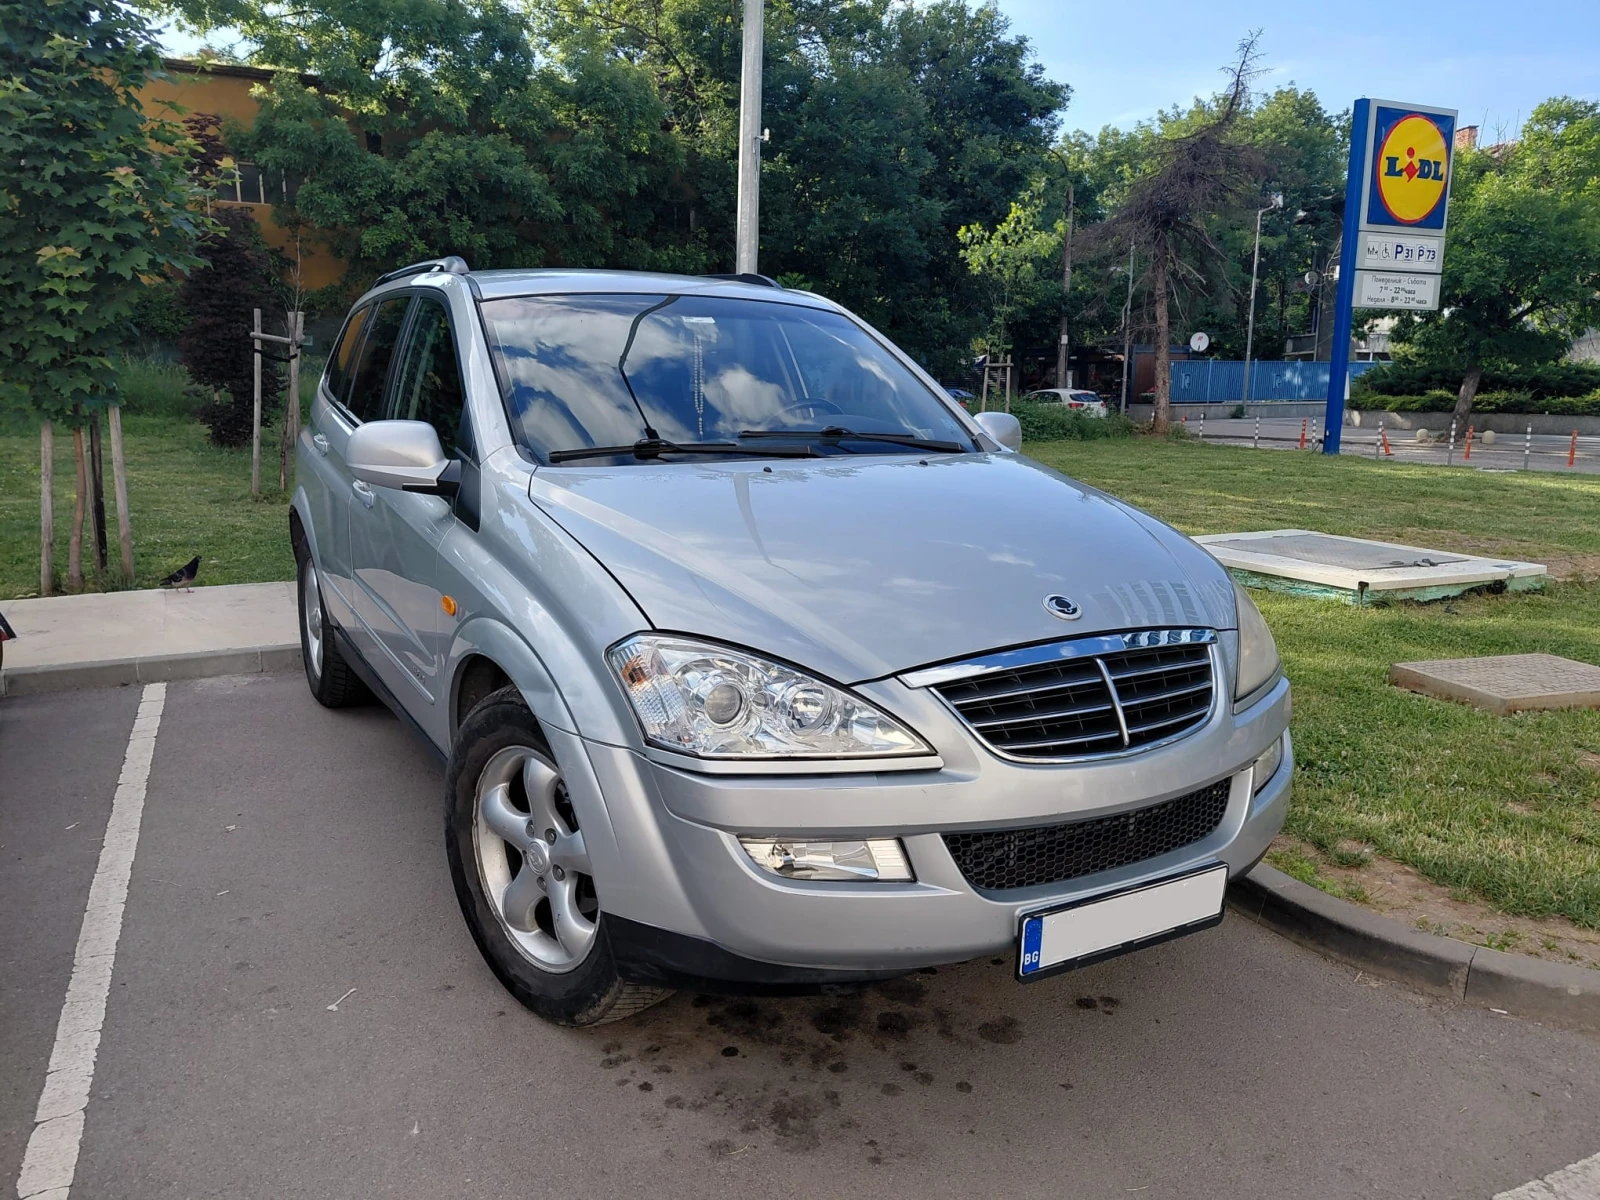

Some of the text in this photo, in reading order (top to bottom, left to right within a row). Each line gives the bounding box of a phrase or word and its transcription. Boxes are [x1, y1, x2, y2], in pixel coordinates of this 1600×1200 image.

[1394, 244, 1436, 261] P 31 P 73
[1367, 295, 1385, 304] Неделя
[1024, 951, 1039, 965] BG
